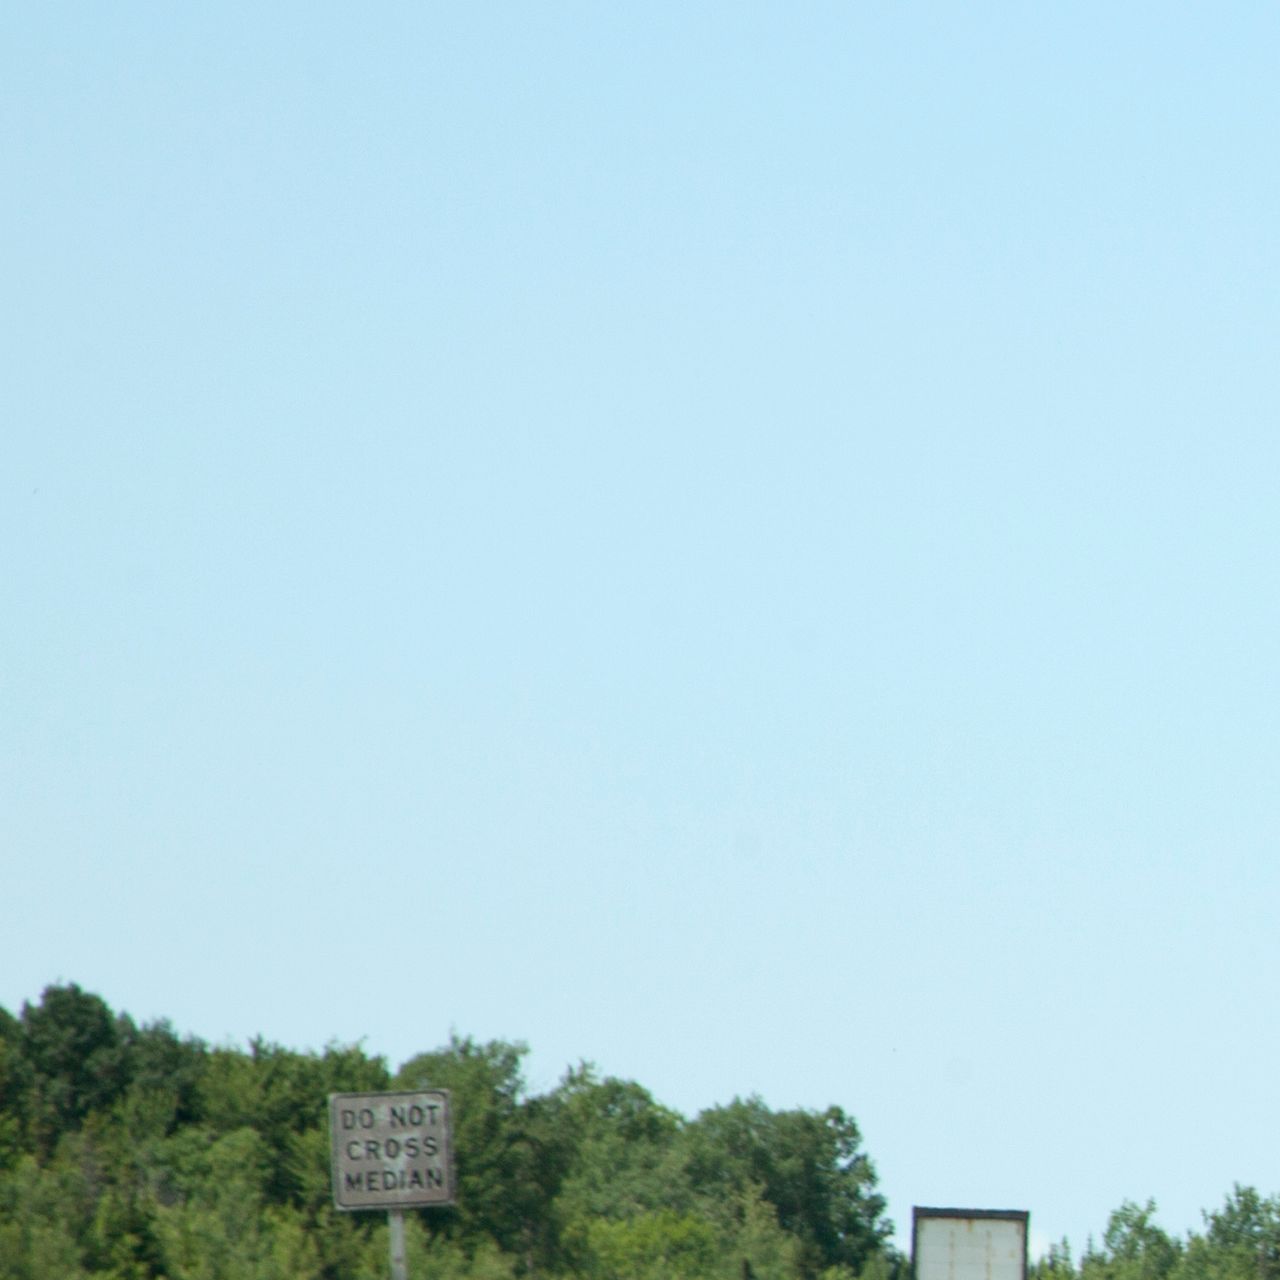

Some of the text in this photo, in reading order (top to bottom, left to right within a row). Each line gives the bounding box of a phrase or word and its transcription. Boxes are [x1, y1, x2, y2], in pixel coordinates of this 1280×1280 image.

[342, 1104, 438, 1130] DO NOT
[347, 1136, 438, 1161] CROSS
[345, 1168, 442, 1192] MEDIAN
